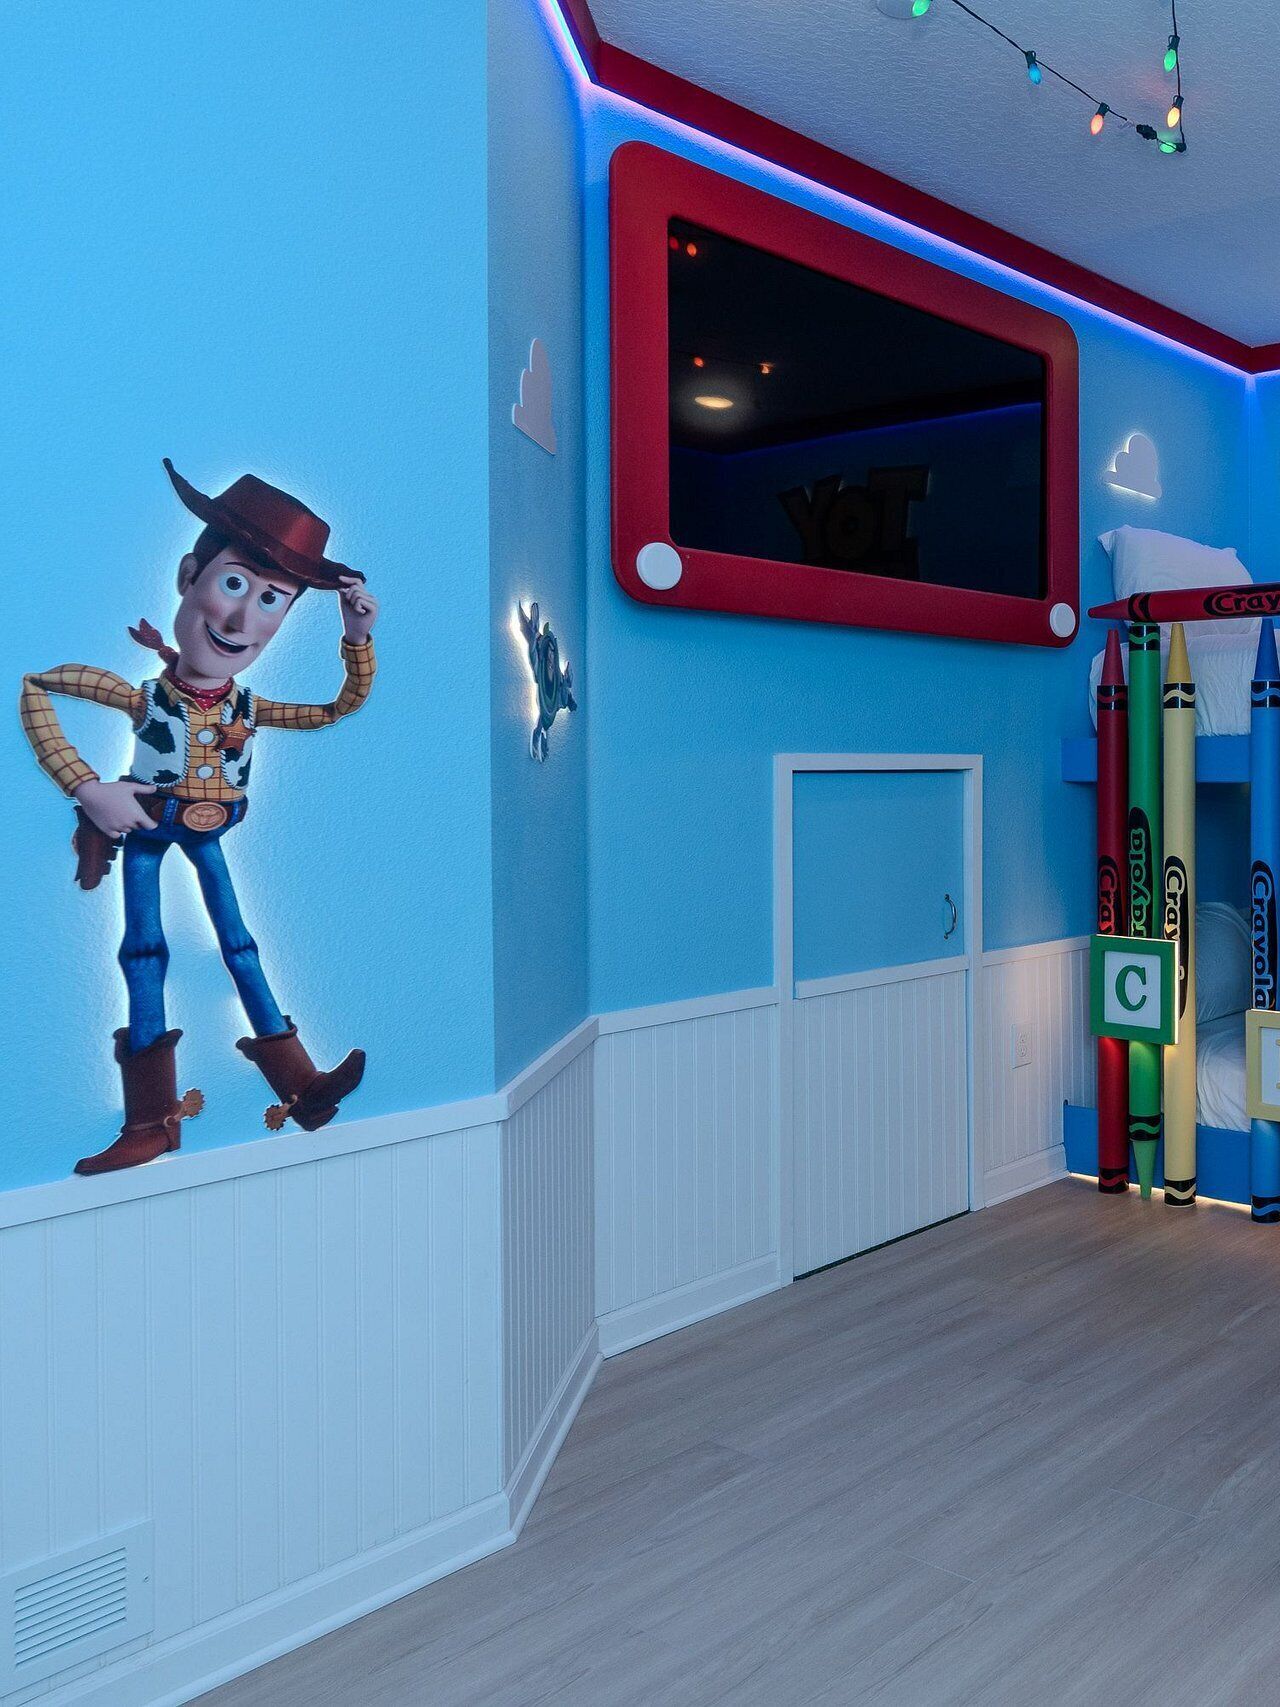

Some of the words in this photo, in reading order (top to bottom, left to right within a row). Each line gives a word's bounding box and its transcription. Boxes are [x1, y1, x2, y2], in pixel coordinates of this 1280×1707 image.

[1129, 828, 1151, 937] rayola
[1164, 866, 1186, 940] Cray
[1252, 871, 1273, 1009] Crayola
[1114, 964, 1148, 1011] C
